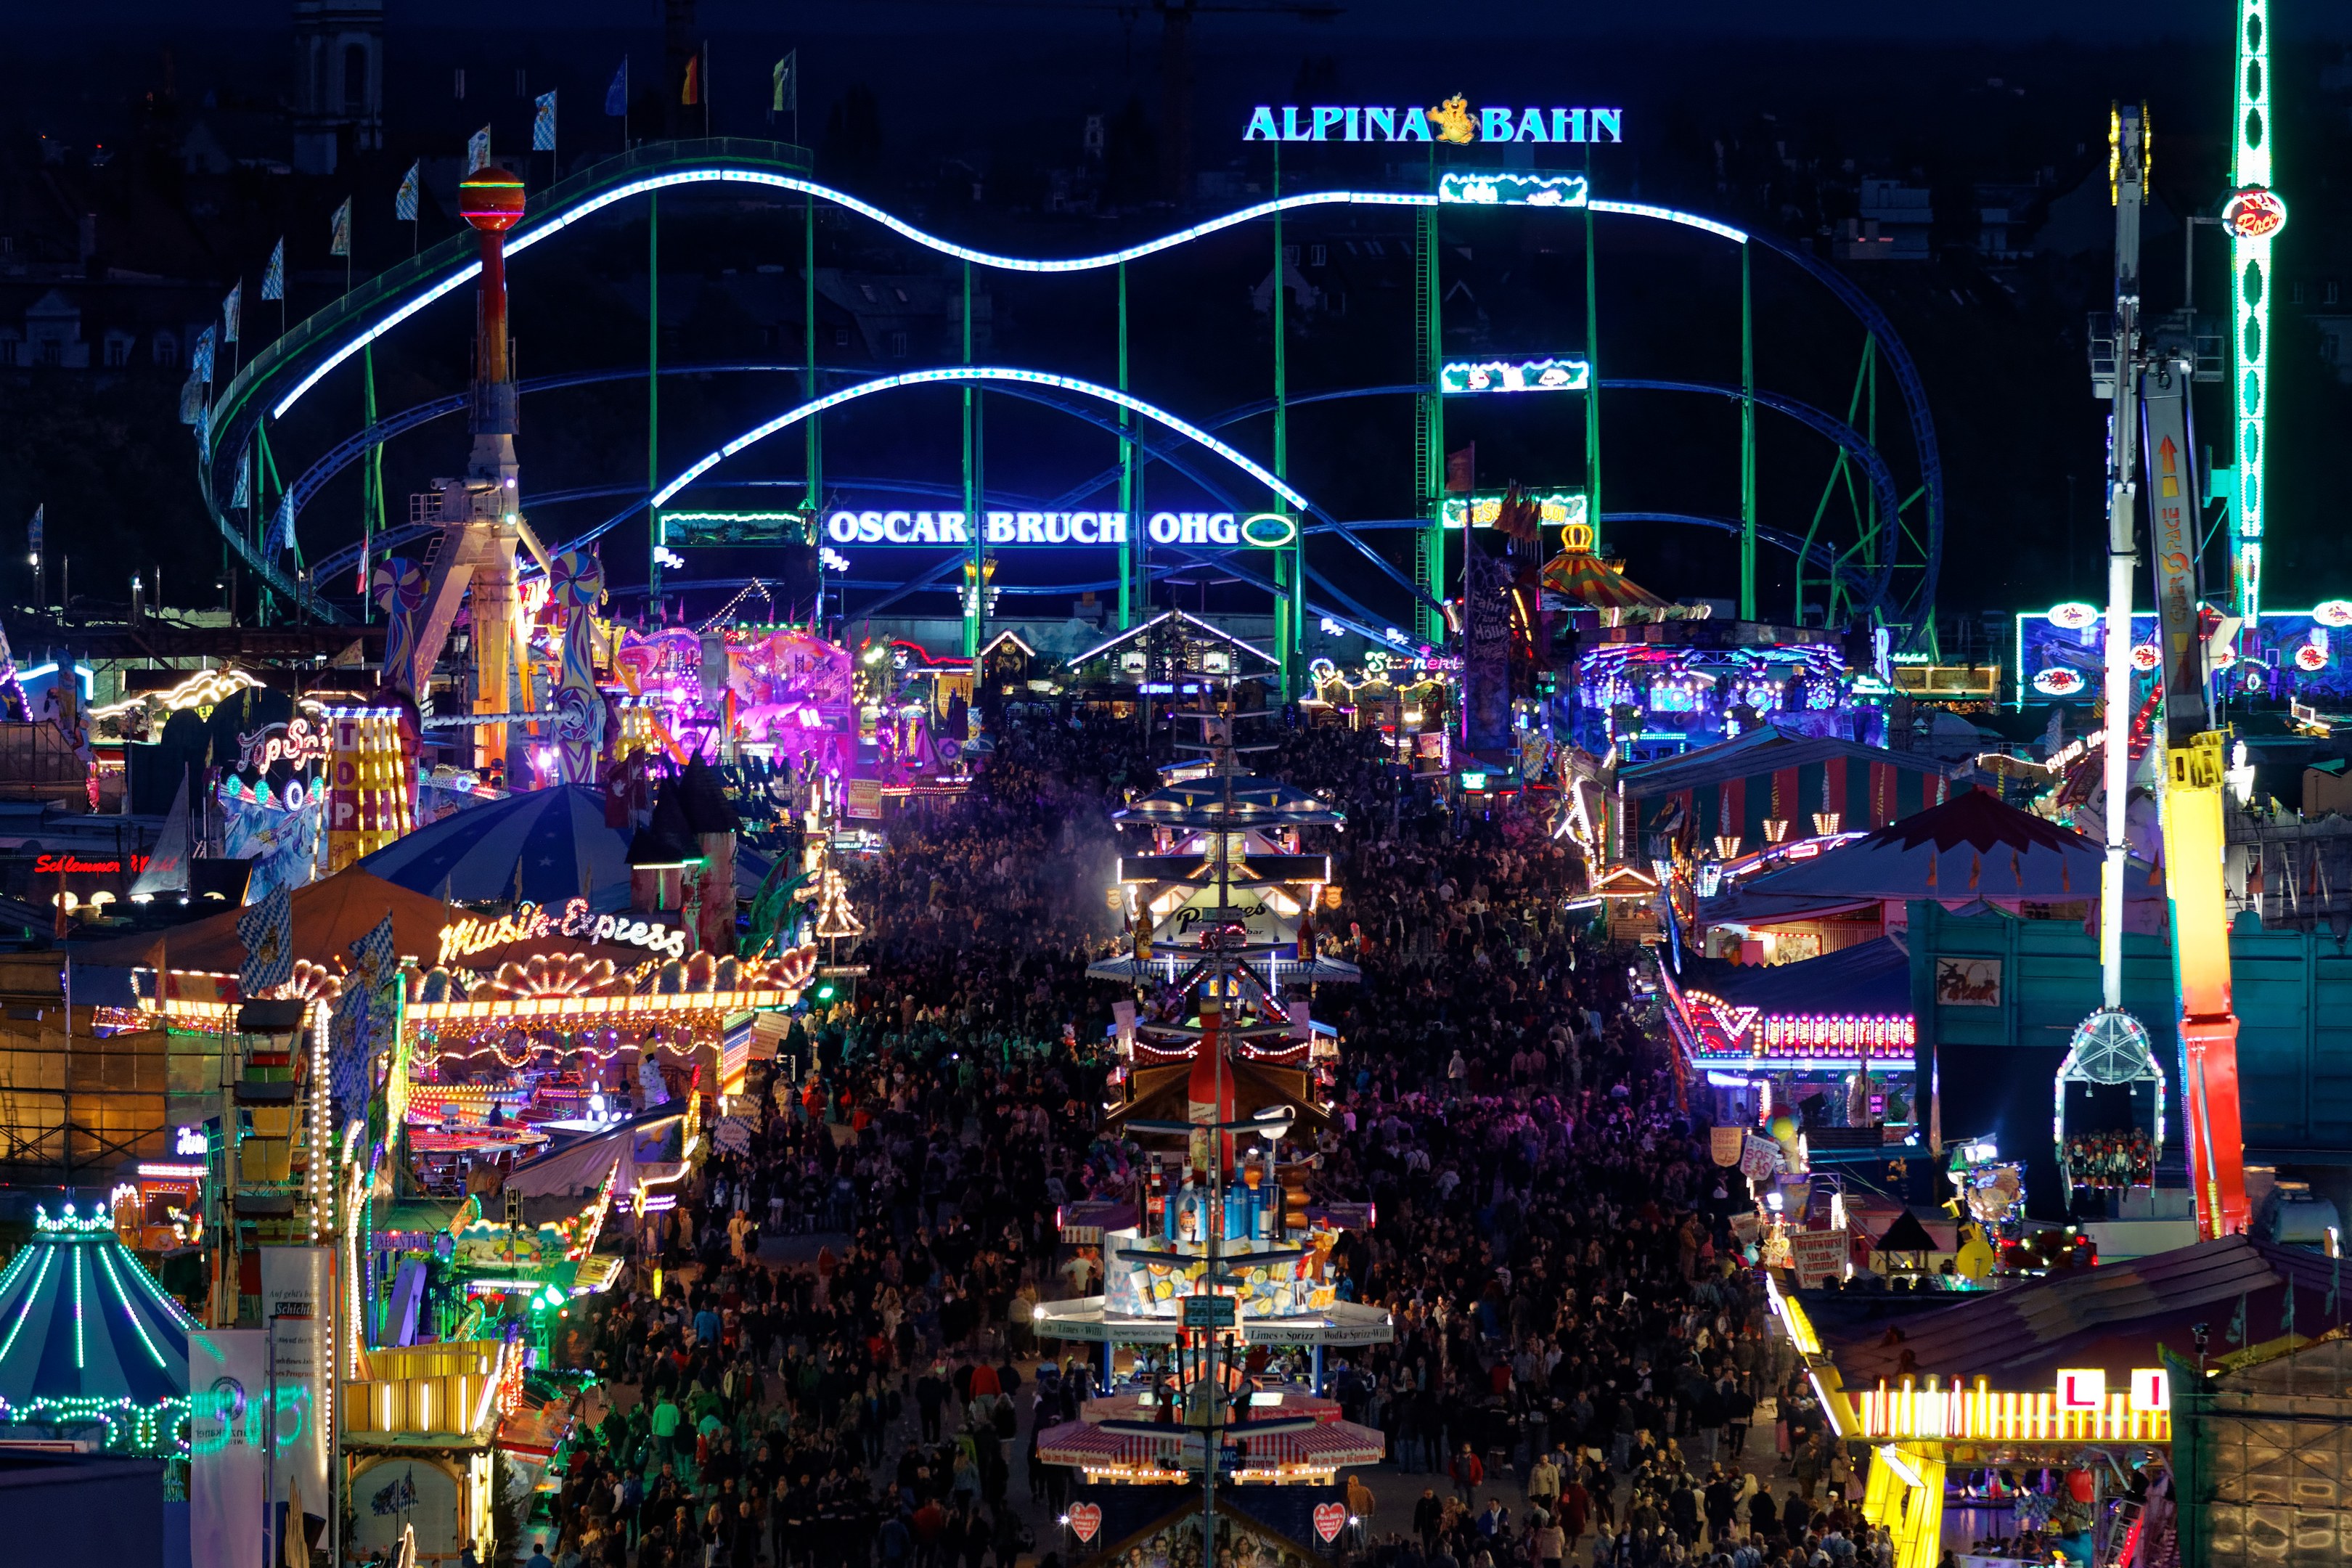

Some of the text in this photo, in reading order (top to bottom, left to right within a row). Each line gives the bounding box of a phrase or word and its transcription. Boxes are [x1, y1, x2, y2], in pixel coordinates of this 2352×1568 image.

[1243, 107, 1623, 143] ALPINA BAHN
[828, 511, 1238, 544] OSCAR BRUCH OHG
[2045, 739, 2083, 775] RUND
[34, 854, 121, 873] Schlemmer
[438, 898, 686, 965] Musik-Express
[1209, 979, 1239, 997] ES
[1746, 1148, 1776, 1161] SOFT
[1796, 1237, 1842, 1251] Bratwurst
[1802, 1259, 1839, 1272] semmel
[1250, 1329, 1315, 1342] Limes Sprizz
[1220, 1450, 1237, 1462] WC
